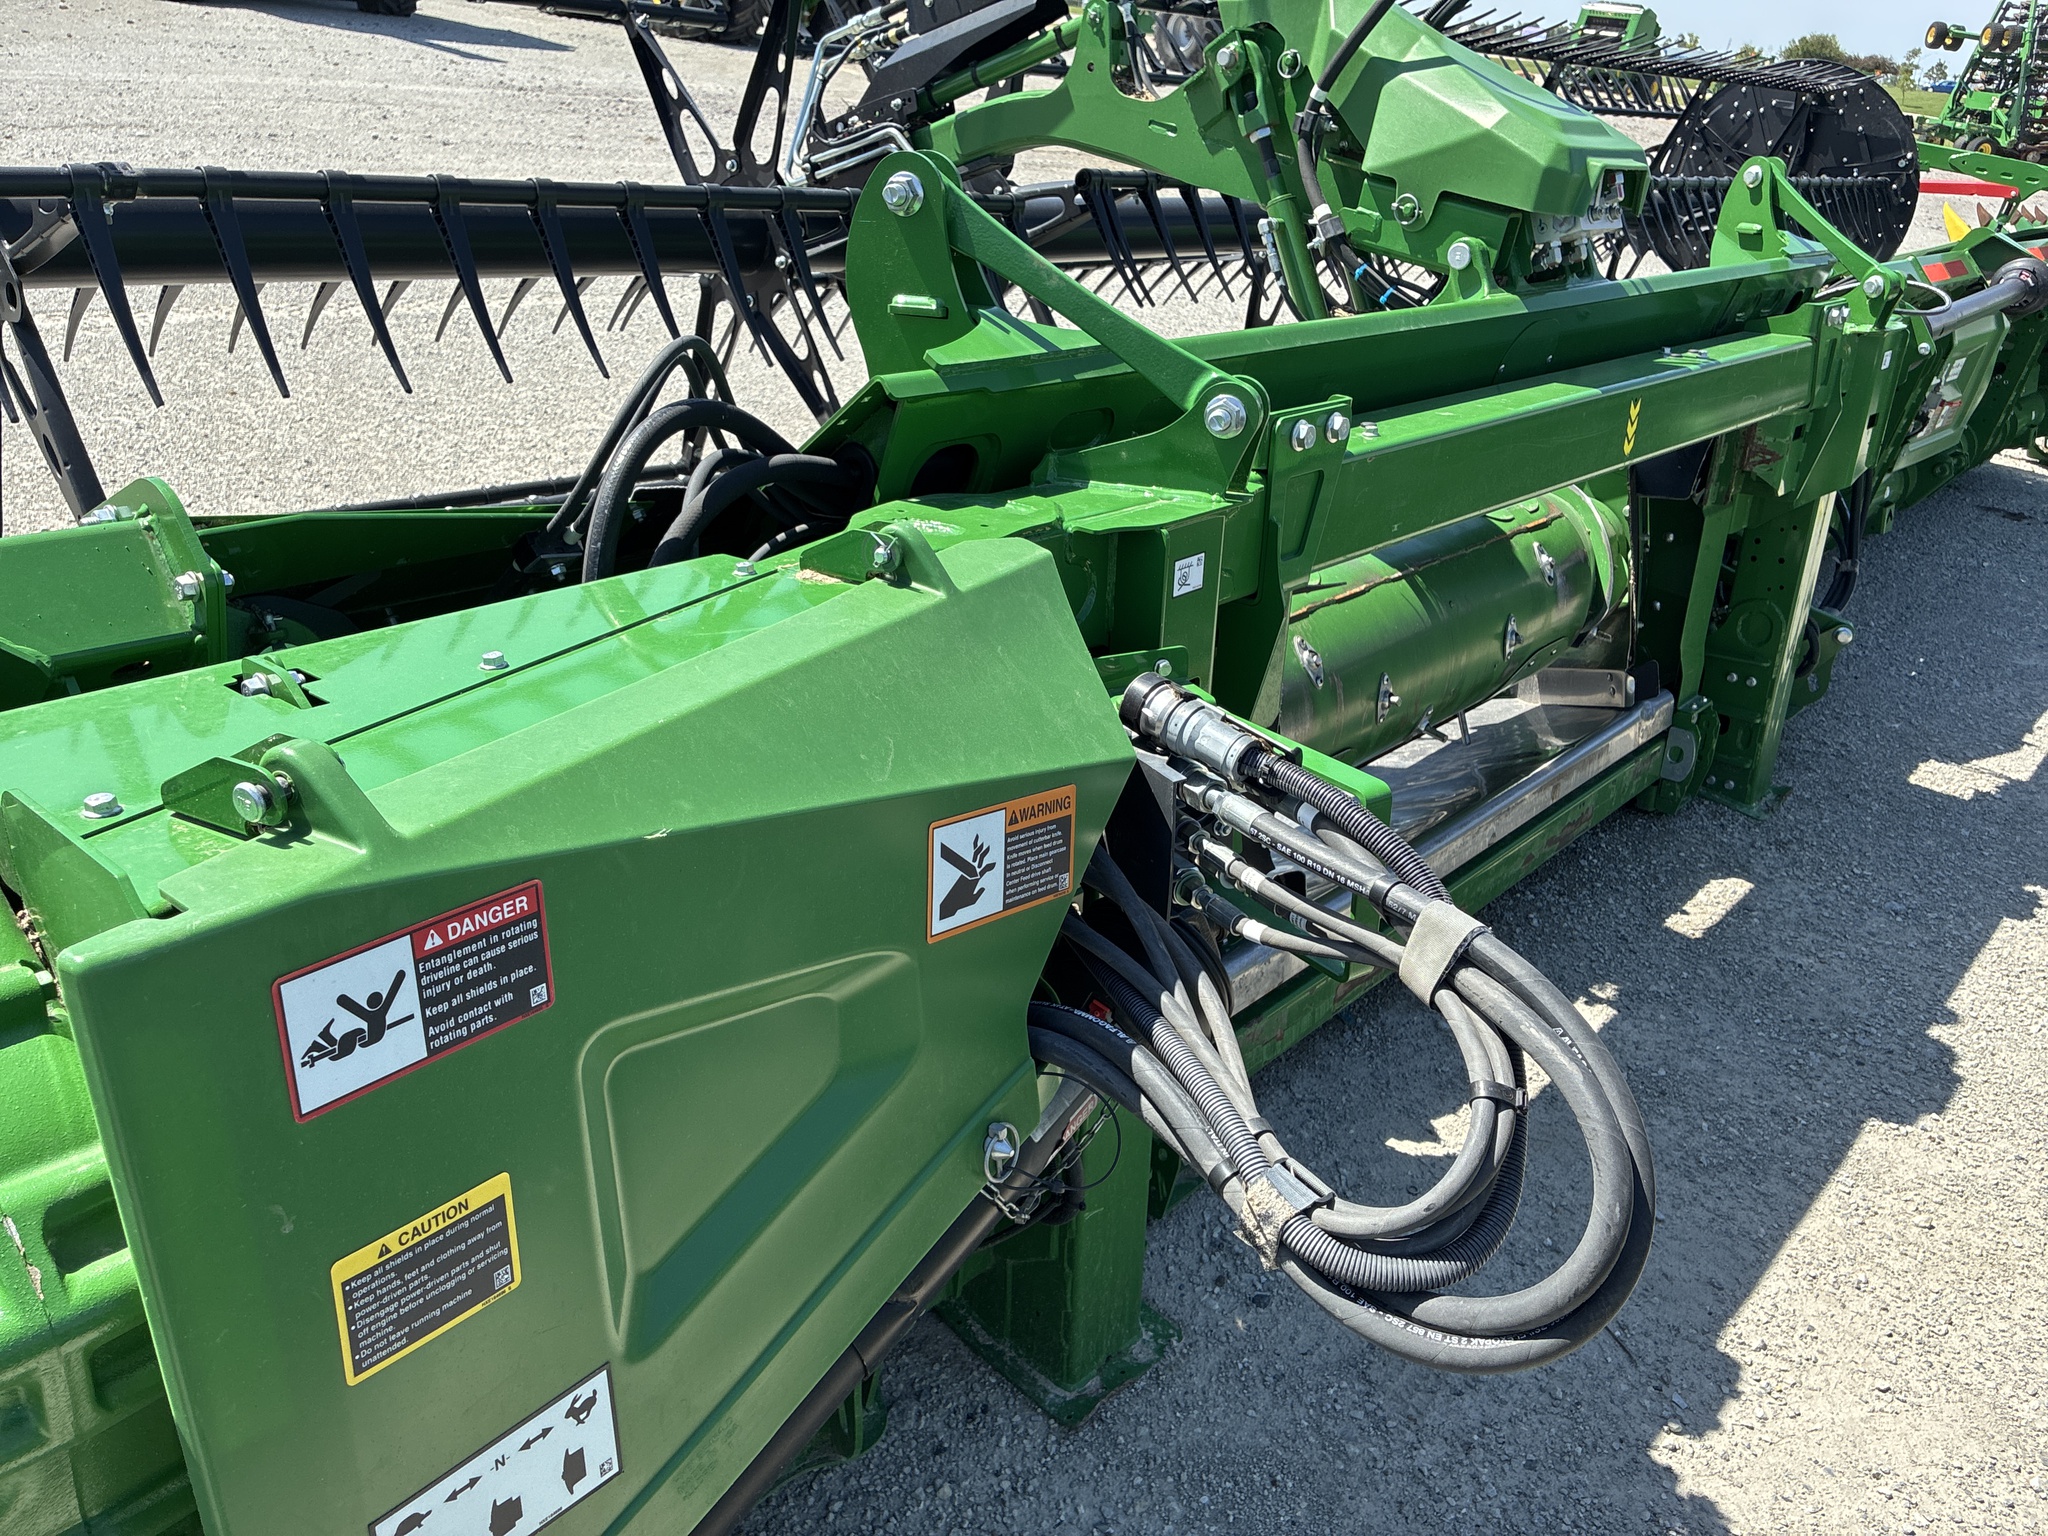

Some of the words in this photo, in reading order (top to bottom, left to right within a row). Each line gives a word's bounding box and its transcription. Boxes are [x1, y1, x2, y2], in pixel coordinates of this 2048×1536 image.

[1019, 796, 1071, 822] WARNING
[1277, 843, 1292, 856] SAE
[1293, 852, 1306, 864] 100
[1307, 859, 1322, 872] R19
[1323, 868, 1334, 879] DN
[1336, 874, 1346, 884] 16
[447, 896, 528, 940] DANGER
[418, 938, 487, 973] Entanglement
[490, 934, 498, 944] in
[502, 918, 538, 940] rotating
[420, 964, 460, 986] driveline
[463, 956, 478, 968] can
[481, 946, 506, 962] cause
[508, 930, 538, 950] serious
[422, 980, 450, 999] injury
[454, 975, 464, 986] or
[467, 961, 496, 982] death.
[425, 1002, 448, 1018] Keep
[452, 993, 462, 1007] all
[466, 980, 498, 1000] shields
[500, 975, 508, 986] in
[511, 964, 536, 982] place.
[428, 1016, 454, 1037] Avoid
[458, 1002, 492, 1024] contact
[494, 992, 514, 1008] with
[430, 1026, 468, 1049] rotating
[470, 1014, 497, 1033] parts.
[1063, 1100, 1095, 1140] ANGER
[398, 1198, 470, 1246] CAUTION
[351, 1274, 372, 1288] Keep
[374, 1266, 384, 1278] all
[386, 1251, 414, 1272] shields
[415, 1246, 422, 1255] in
[424, 1234, 444, 1252] place
[446, 1220, 469, 1238] during
[470, 1204, 495, 1222] normal
[354, 1294, 374, 1308] Keep
[376, 1278, 404, 1297] hands,
[404, 1268, 420, 1281] feet
[420, 1260, 435, 1273] and
[436, 1244, 466, 1265] clothing
[468, 1232, 484, 1246] away
[486, 1220, 502, 1234] from
[352, 1271, 398, 1300] operations.
[354, 1284, 408, 1320] power-driven
[409, 1274, 430, 1292] parts.
[356, 1299, 400, 1328] Disengage
[400, 1272, 450, 1306] power-driven
[451, 1262, 470, 1278] parts
[470, 1252, 484, 1264] and
[486, 1240, 500, 1256] shut
[358, 1328, 369, 1339] off
[371, 1312, 398, 1333] engine
[400, 1298, 424, 1316] before
[426, 1271, 466, 1300] unclogging
[468, 1266, 476, 1276] or
[477, 1247, 508, 1270] servicing
[1340, 1286, 1356, 1298] 100
[360, 1348, 372, 1359] Do
[374, 1339, 388, 1352] not
[389, 1326, 410, 1344] leave
[411, 1307, 440, 1330] running
[442, 1288, 472, 1312] machine
[1356, 1296, 1378, 1314] SAE
[1384, 1314, 1406, 1328] 2SC
[358, 1326, 396, 1348] machine.
[1406, 1324, 1426, 1336] 857
[1427, 1332, 1442, 1342] EN
[1444, 1335, 1459, 1344] ST
[1462, 1337, 1468, 1345] 2
[362, 1338, 409, 1368] unattended.
